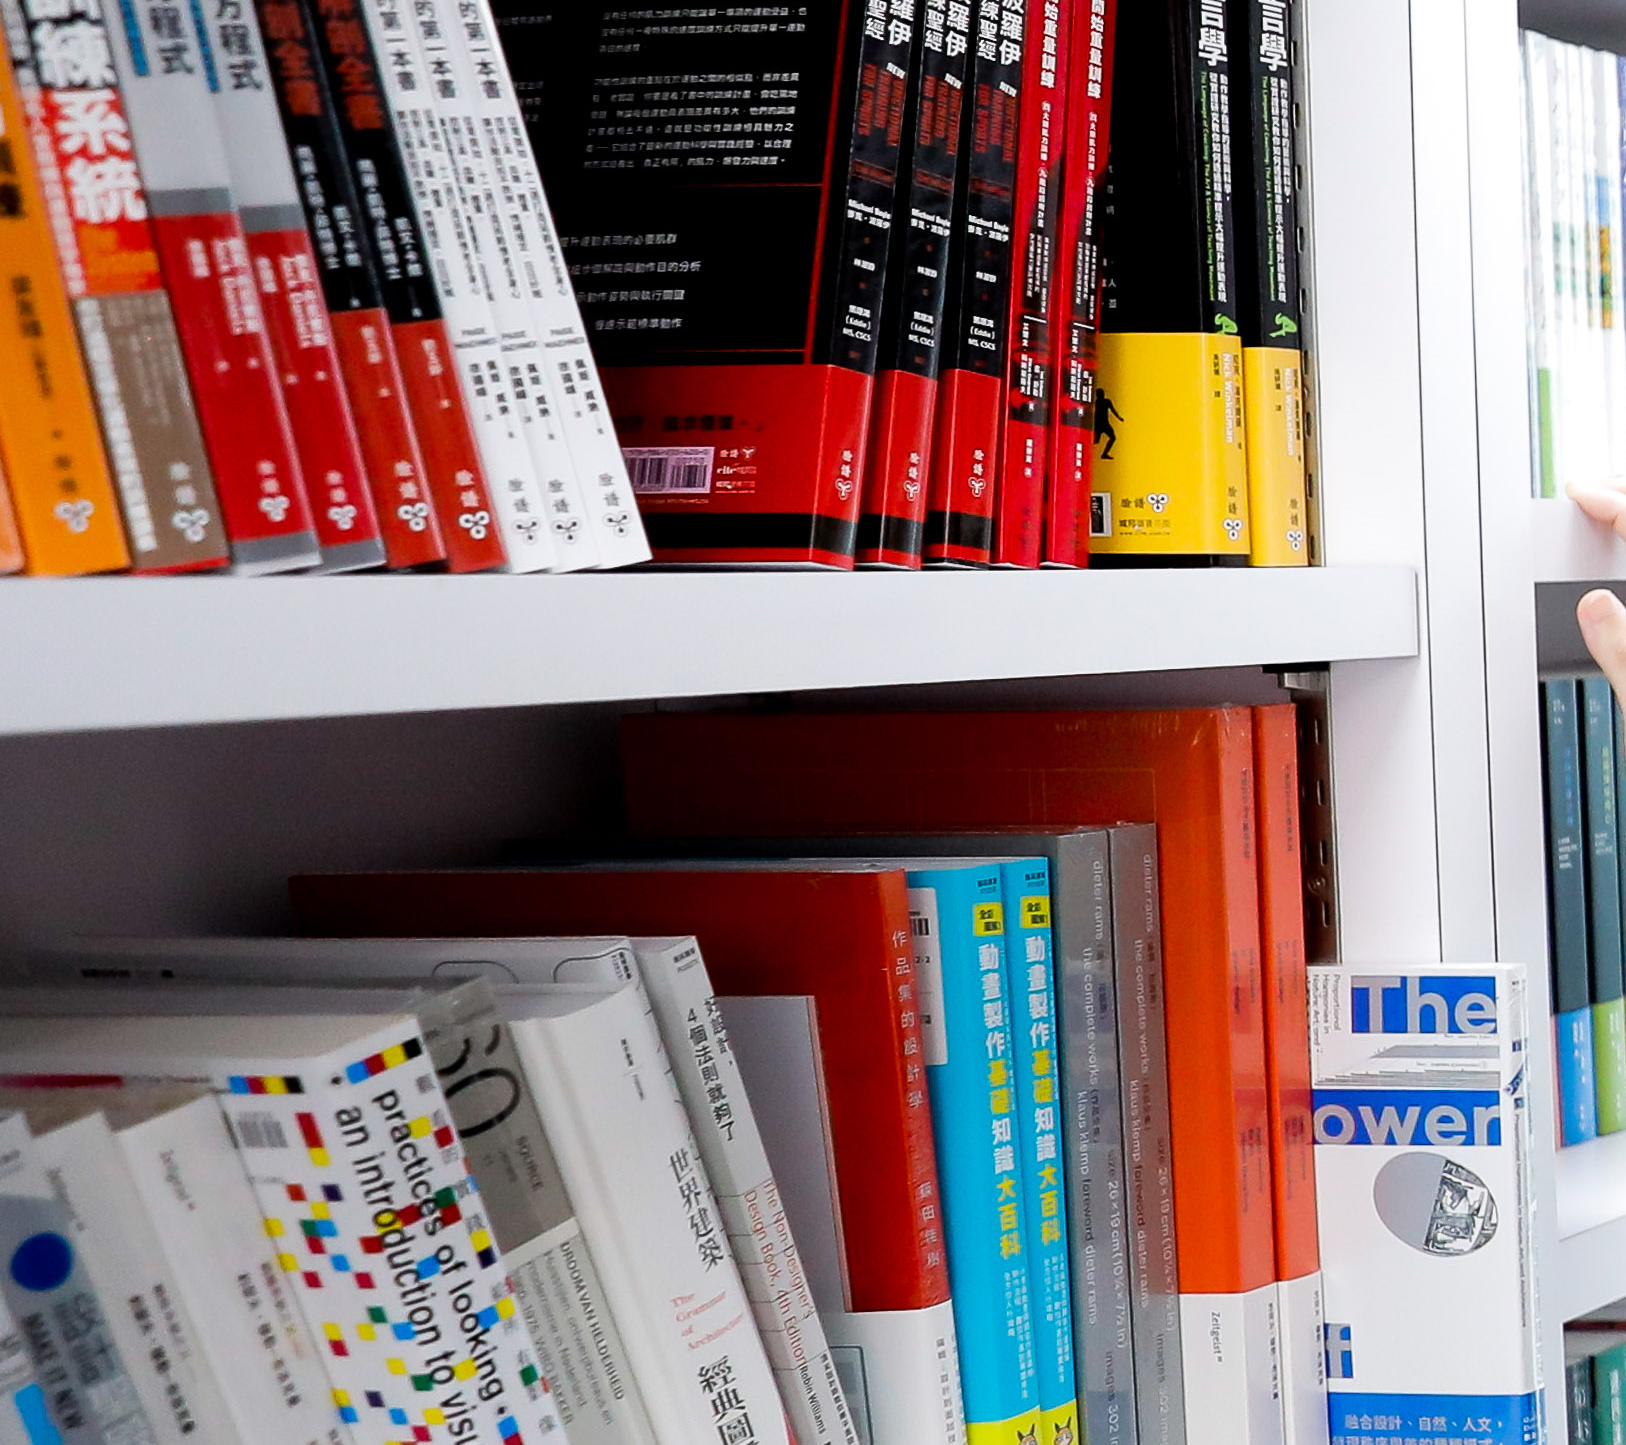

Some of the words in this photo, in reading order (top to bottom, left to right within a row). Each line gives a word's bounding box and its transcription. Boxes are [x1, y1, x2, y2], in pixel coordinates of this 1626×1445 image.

[1094, 905, 1106, 940] rams
[1083, 947, 1094, 971] the
[890, 928, 926, 1111] 作品集的設計學
[1083, 974, 1096, 1041] complete
[1351, 976, 1497, 1034] The
[1087, 1044, 1100, 1085] works
[1077, 1090, 1089, 1128] klaus
[1312, 1104, 1501, 1146] ower
[372, 1088, 446, 1237] practices
[1079, 1131, 1091, 1176] klemp
[744, 1191, 768, 1237] Design
[334, 1102, 363, 1146] an
[425, 1346, 455, 1386] to
[434, 1246, 468, 1283] of
[1084, 1244, 1097, 1286] dieter
[1086, 1289, 1099, 1325] rams
[449, 1281, 504, 1401] looking
[1344, 1414, 1504, 1433] 融合設計、自然、人文，
